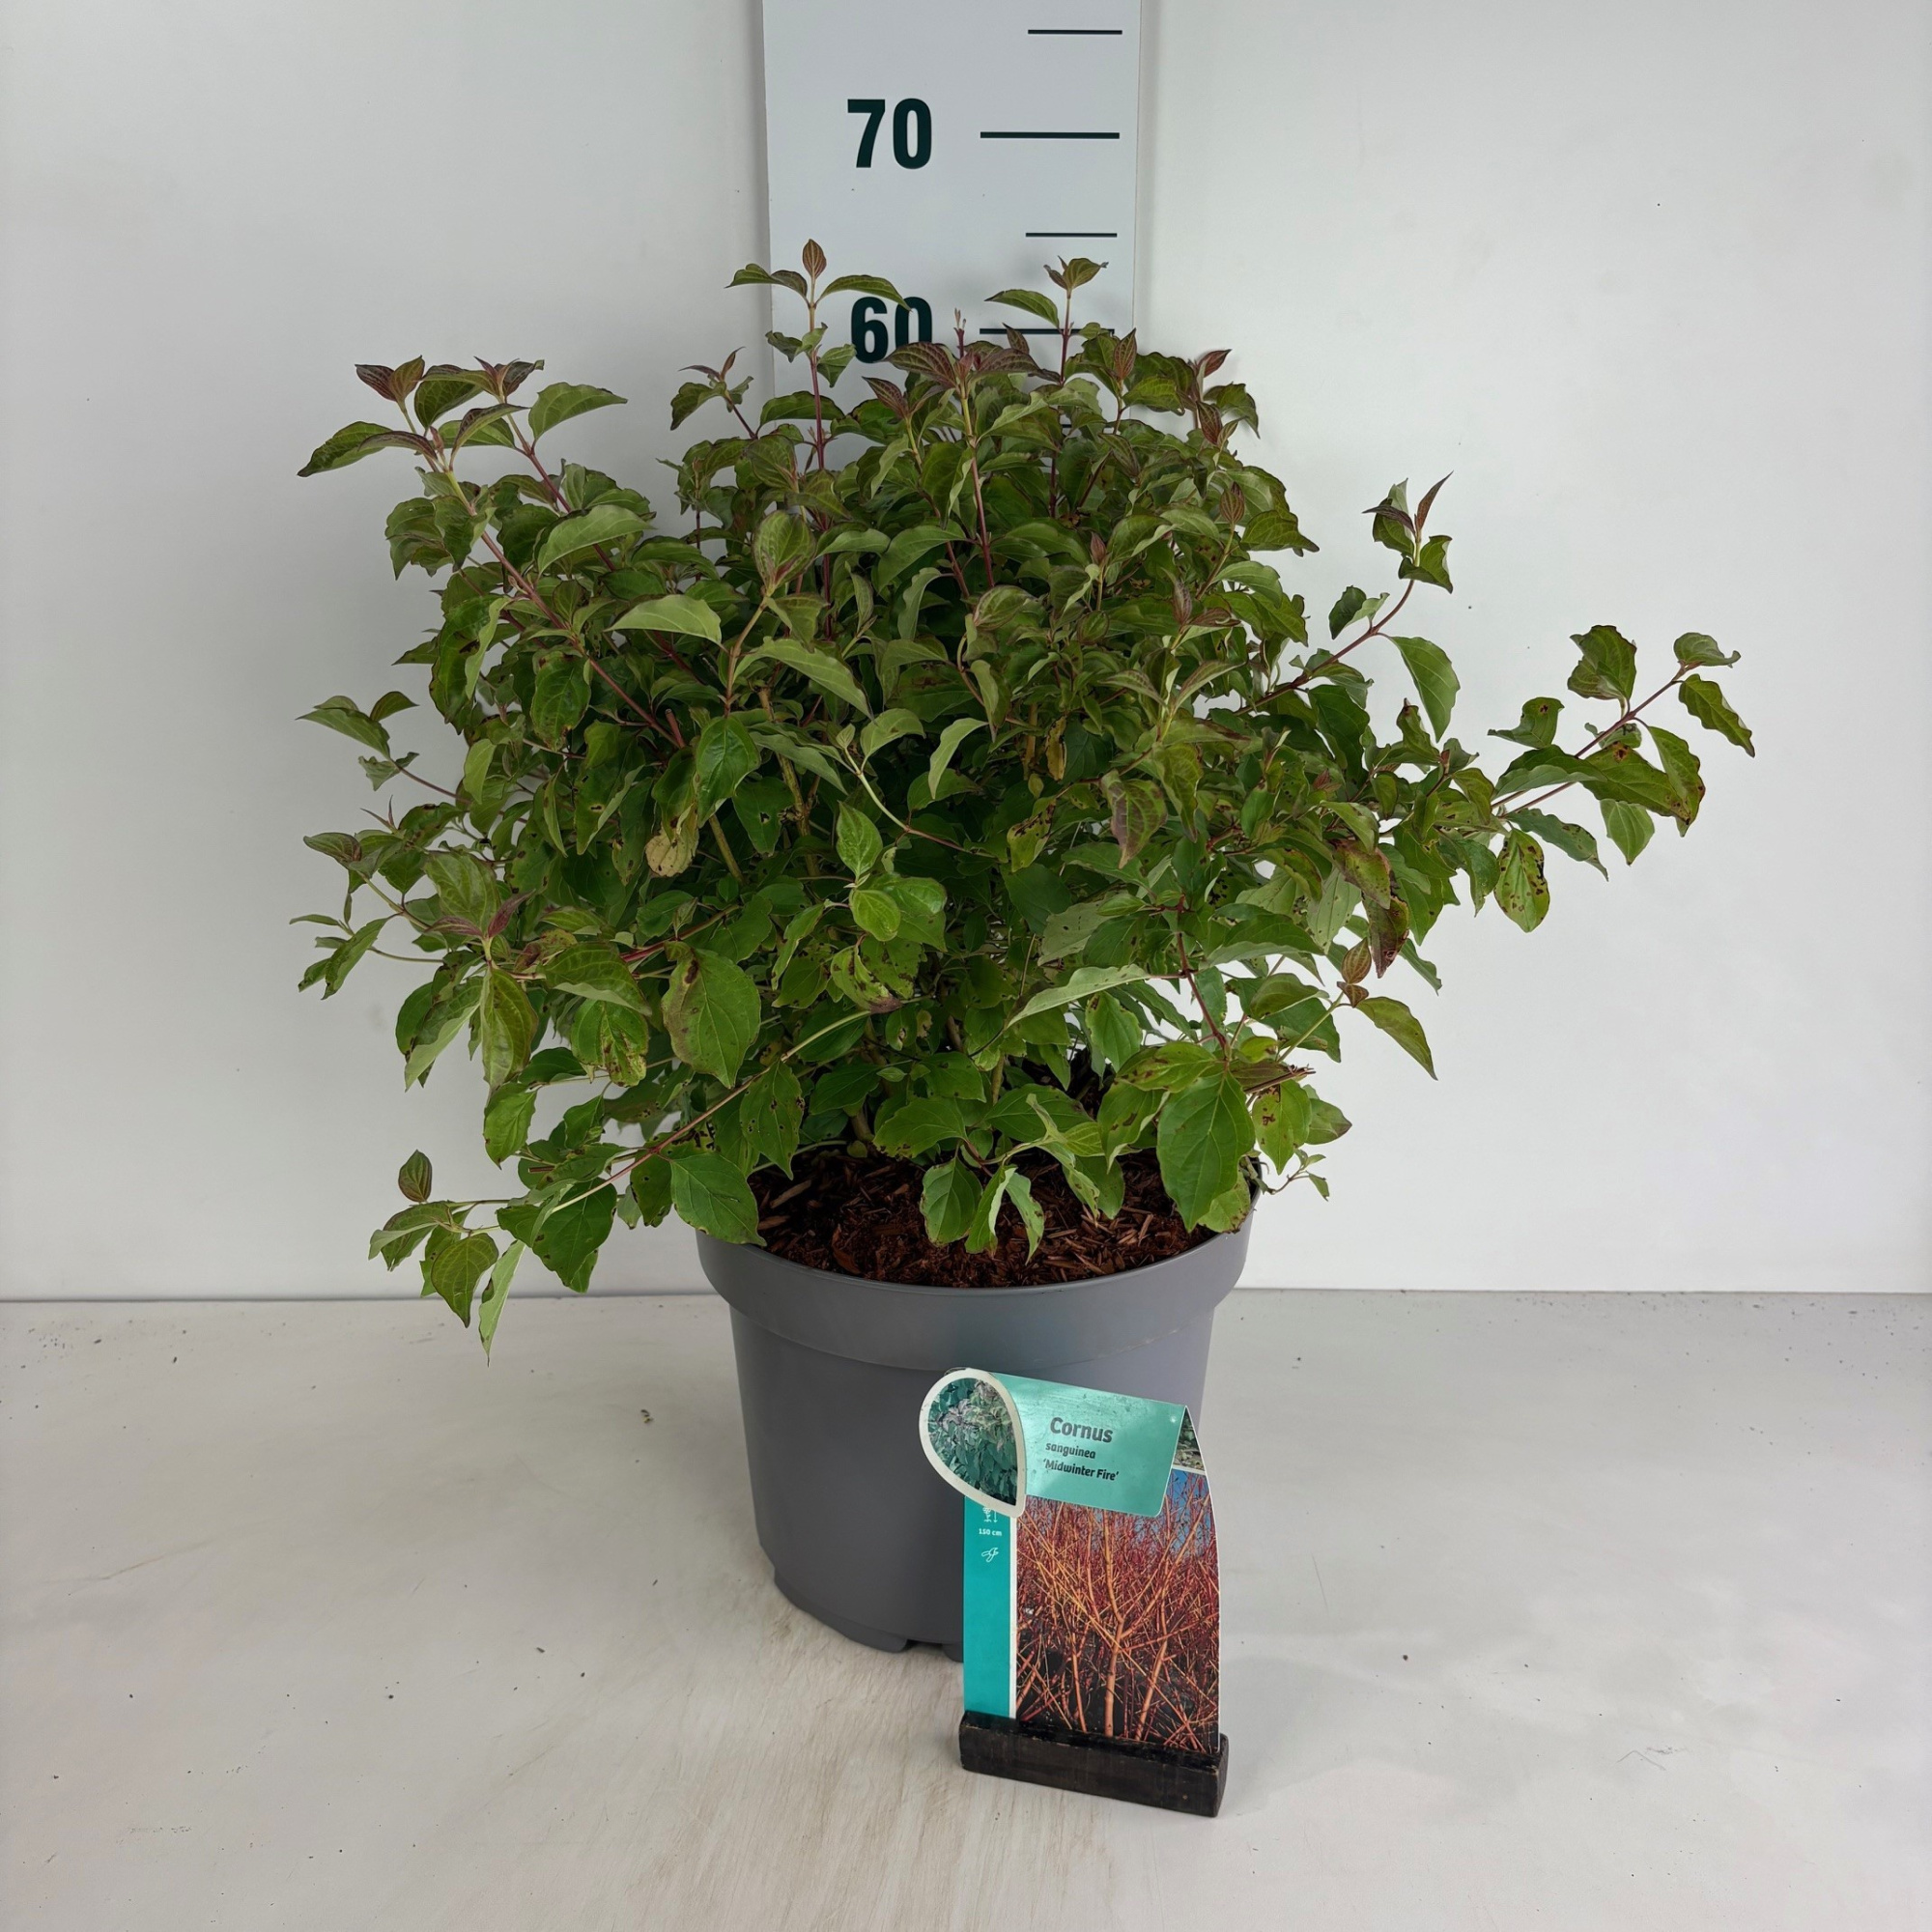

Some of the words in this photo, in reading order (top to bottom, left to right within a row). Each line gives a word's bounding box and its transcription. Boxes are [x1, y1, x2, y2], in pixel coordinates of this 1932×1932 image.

[847, 98, 932, 169] 70
[851, 297, 932, 364] 60
[1045, 1442, 1096, 1459] sanguinea
[1050, 1417, 1113, 1443] Cornus
